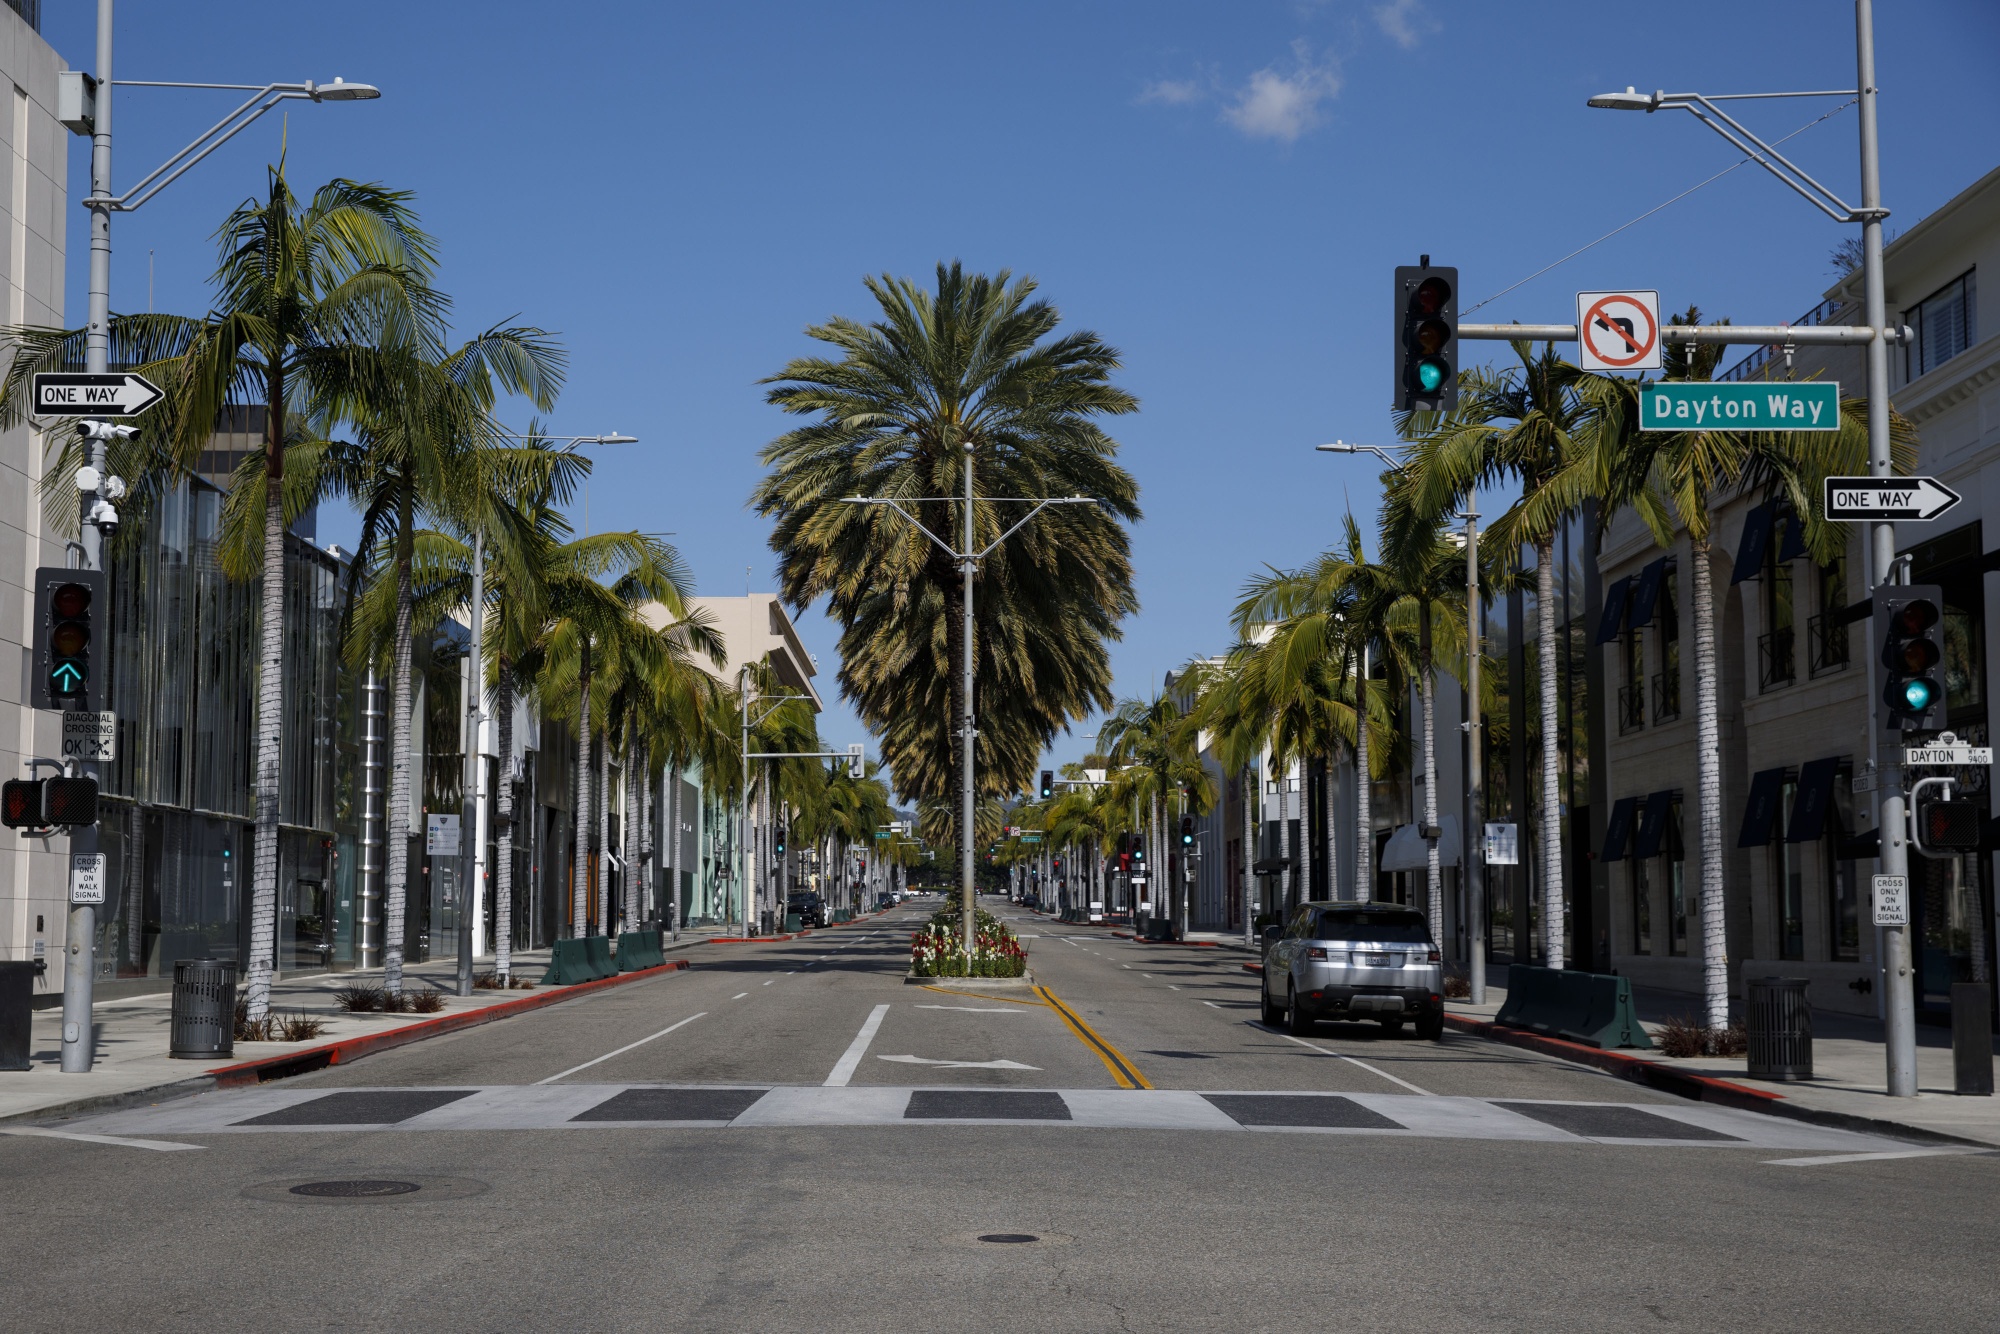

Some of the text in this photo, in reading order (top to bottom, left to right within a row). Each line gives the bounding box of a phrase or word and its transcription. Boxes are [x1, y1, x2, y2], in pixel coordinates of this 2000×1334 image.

[45, 387, 119, 402] ONE WAY
[1654, 394, 1823, 425] Dayton Way
[1837, 492, 1913, 507] ONE WAY
[66, 713, 112, 723] DIAGONAL
[65, 724, 113, 734] CROSSING
[64, 739, 83, 755] OK
[1911, 750, 1954, 762] DAYTON
[1968, 755, 1988, 763] 9400
[75, 891, 101, 899] SIGNAL
[1877, 913, 1905, 921] SIGNAL
